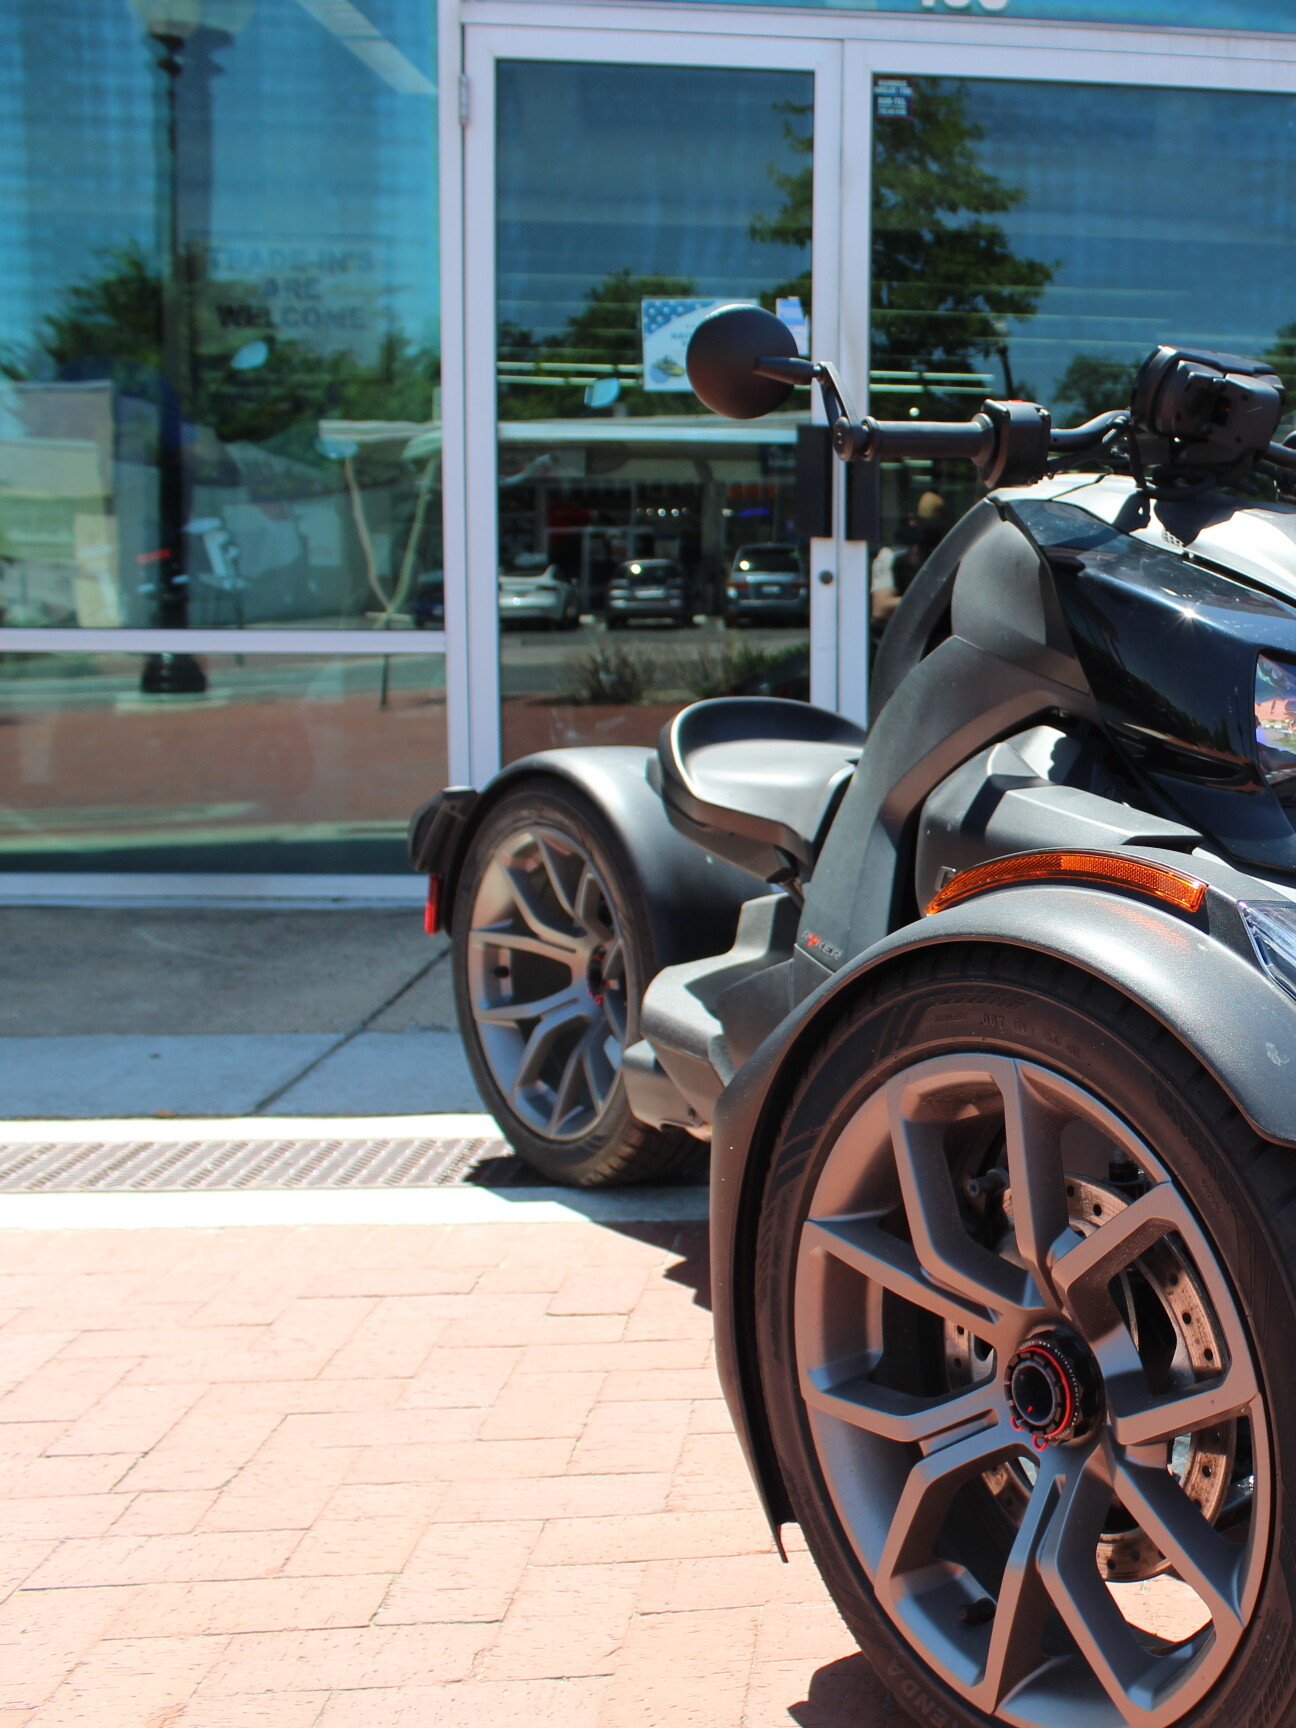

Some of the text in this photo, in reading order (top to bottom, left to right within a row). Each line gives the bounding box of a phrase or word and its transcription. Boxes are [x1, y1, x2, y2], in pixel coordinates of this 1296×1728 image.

[264, 277, 322, 301] ARE
[216, 303, 369, 330] WELCOME
[886, 1658, 960, 1728] ENDA
